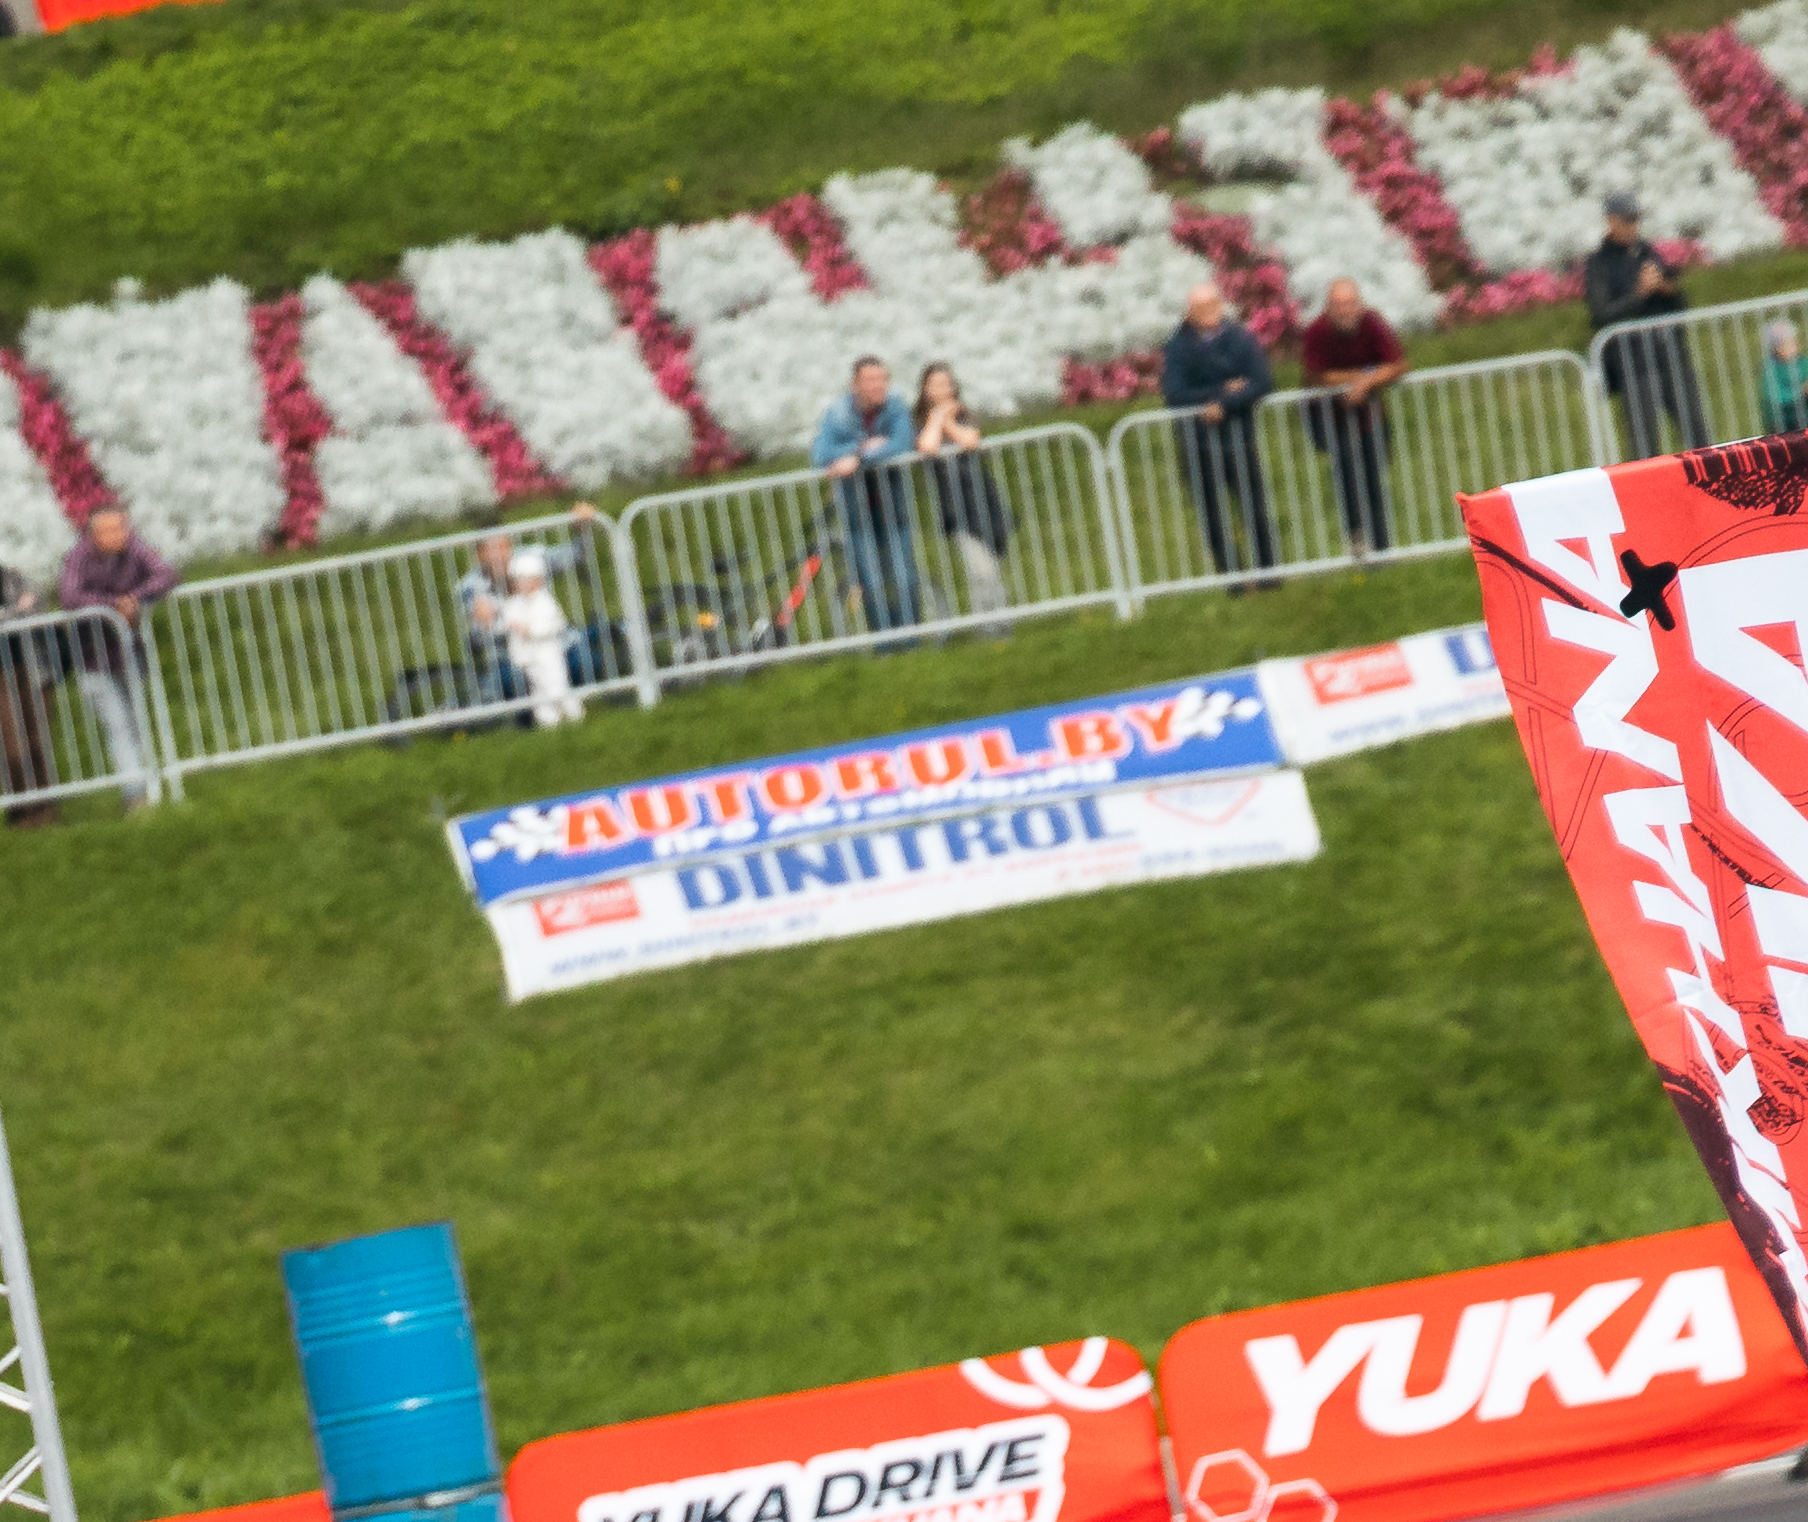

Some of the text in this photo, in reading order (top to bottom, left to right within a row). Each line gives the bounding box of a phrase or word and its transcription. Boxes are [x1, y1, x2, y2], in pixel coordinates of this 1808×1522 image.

[675, 795, 1139, 912] DINITROL
[1243, 1265, 1749, 1458] YUKA
[813, 1432, 1047, 1521] DRIVE
